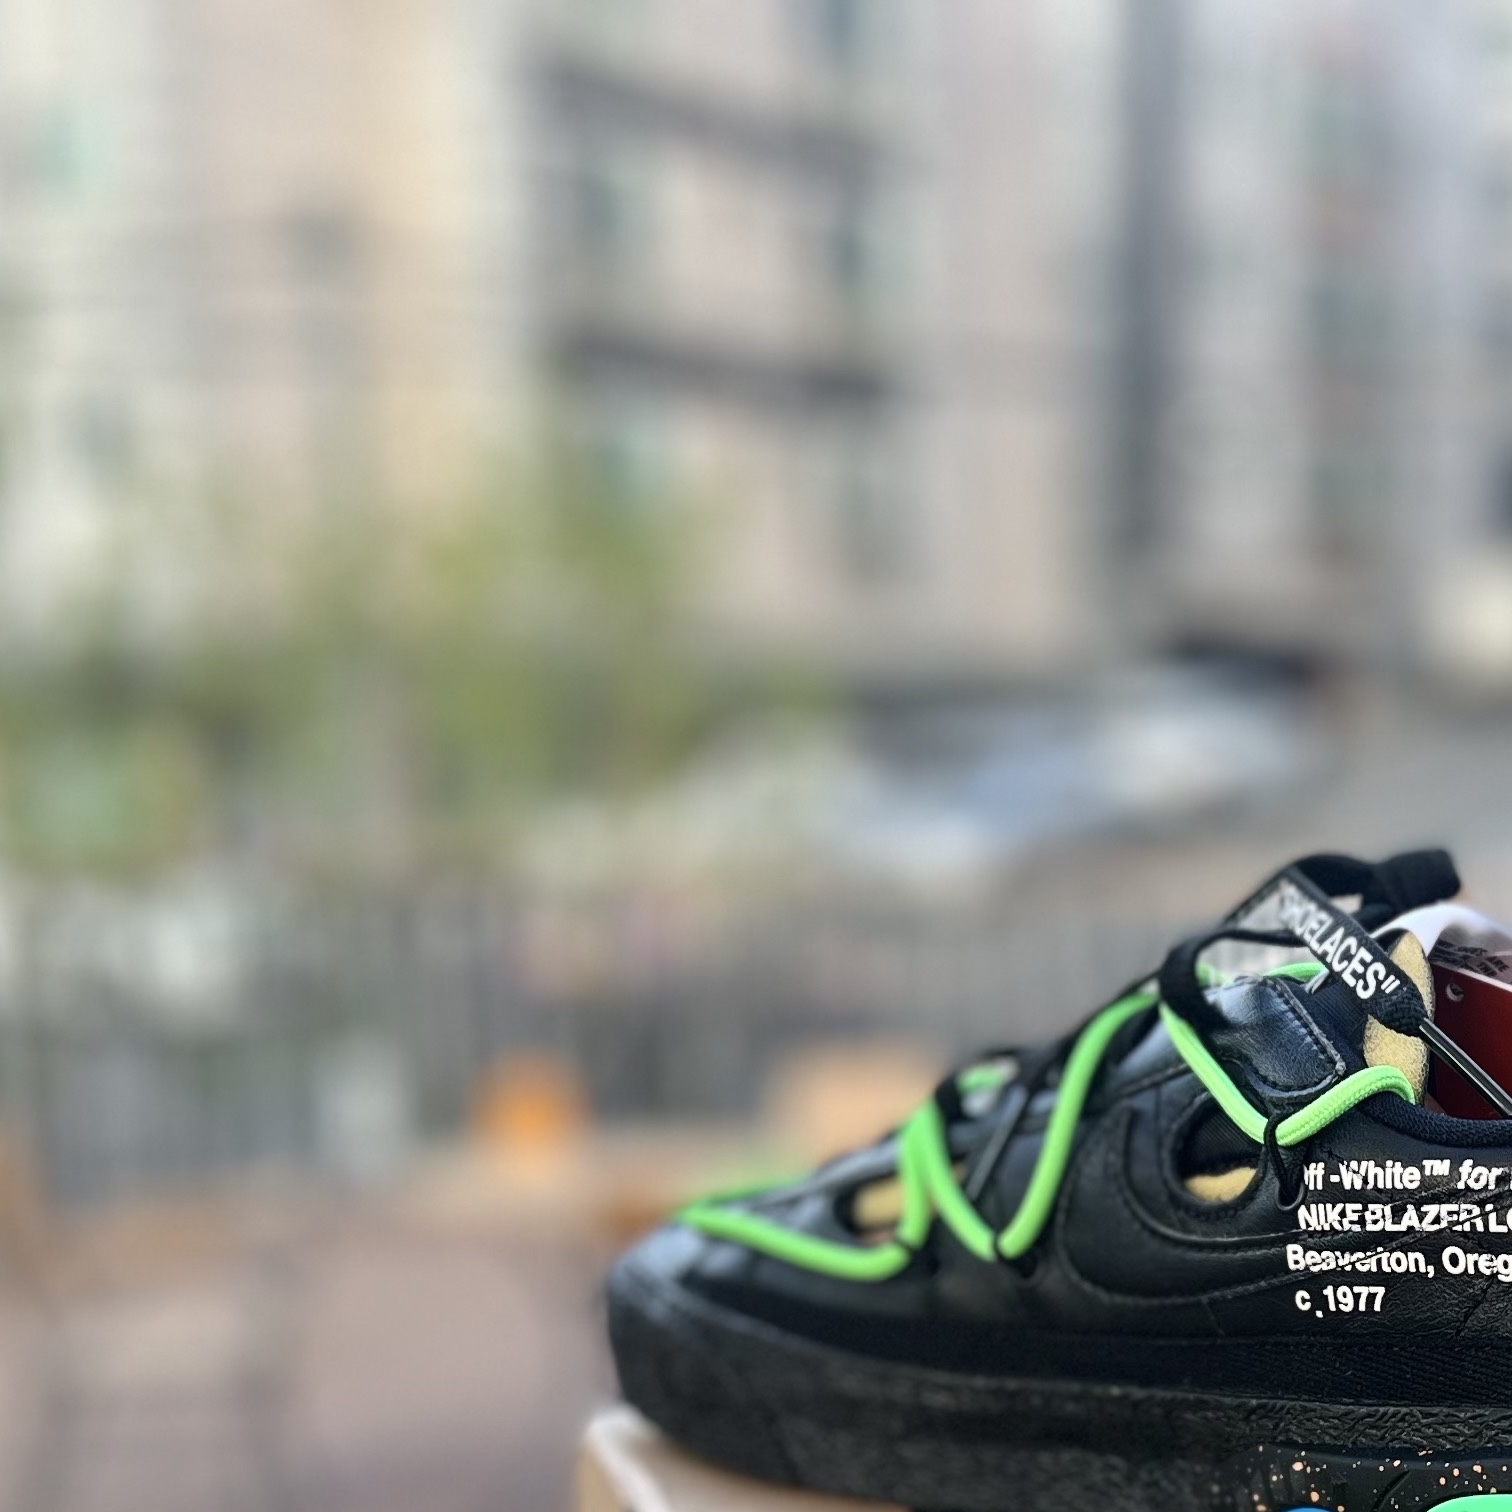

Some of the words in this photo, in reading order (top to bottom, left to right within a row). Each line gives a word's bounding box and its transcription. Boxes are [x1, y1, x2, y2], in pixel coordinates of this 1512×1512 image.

[1456, 1160, 1500, 1192] for
[1286, 1244, 1435, 1278] Beaverton,
[1323, 1285, 1386, 1313] 1977
